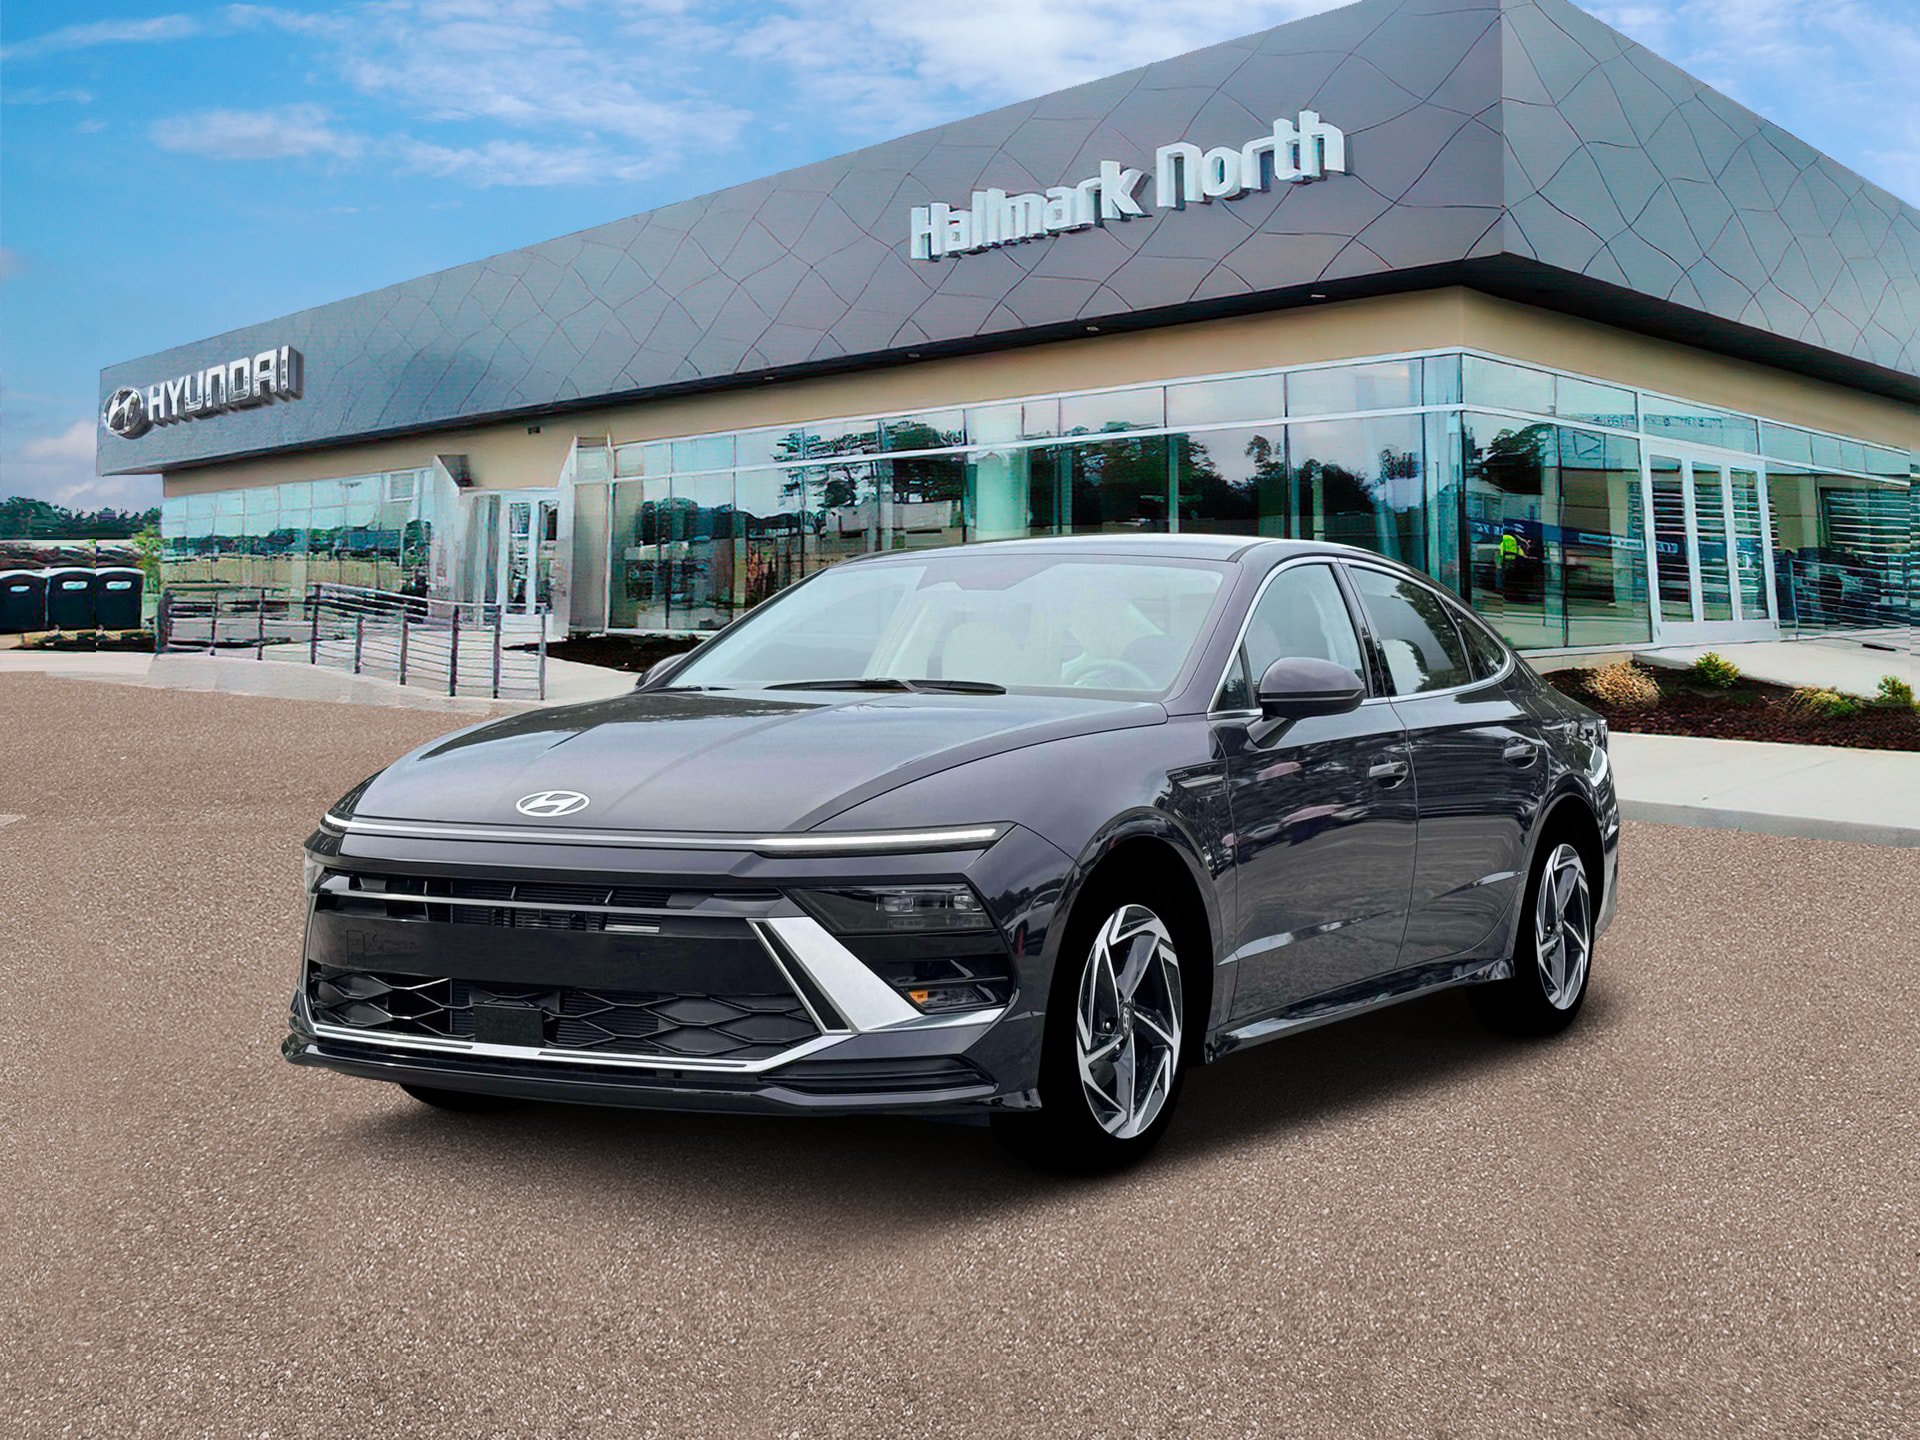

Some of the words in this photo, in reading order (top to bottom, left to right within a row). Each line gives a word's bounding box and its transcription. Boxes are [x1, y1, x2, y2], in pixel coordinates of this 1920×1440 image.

[910, 160, 1150, 261] Hallmark
[1156, 110, 1346, 209] North
[148, 345, 291, 422] HYUNDAI
